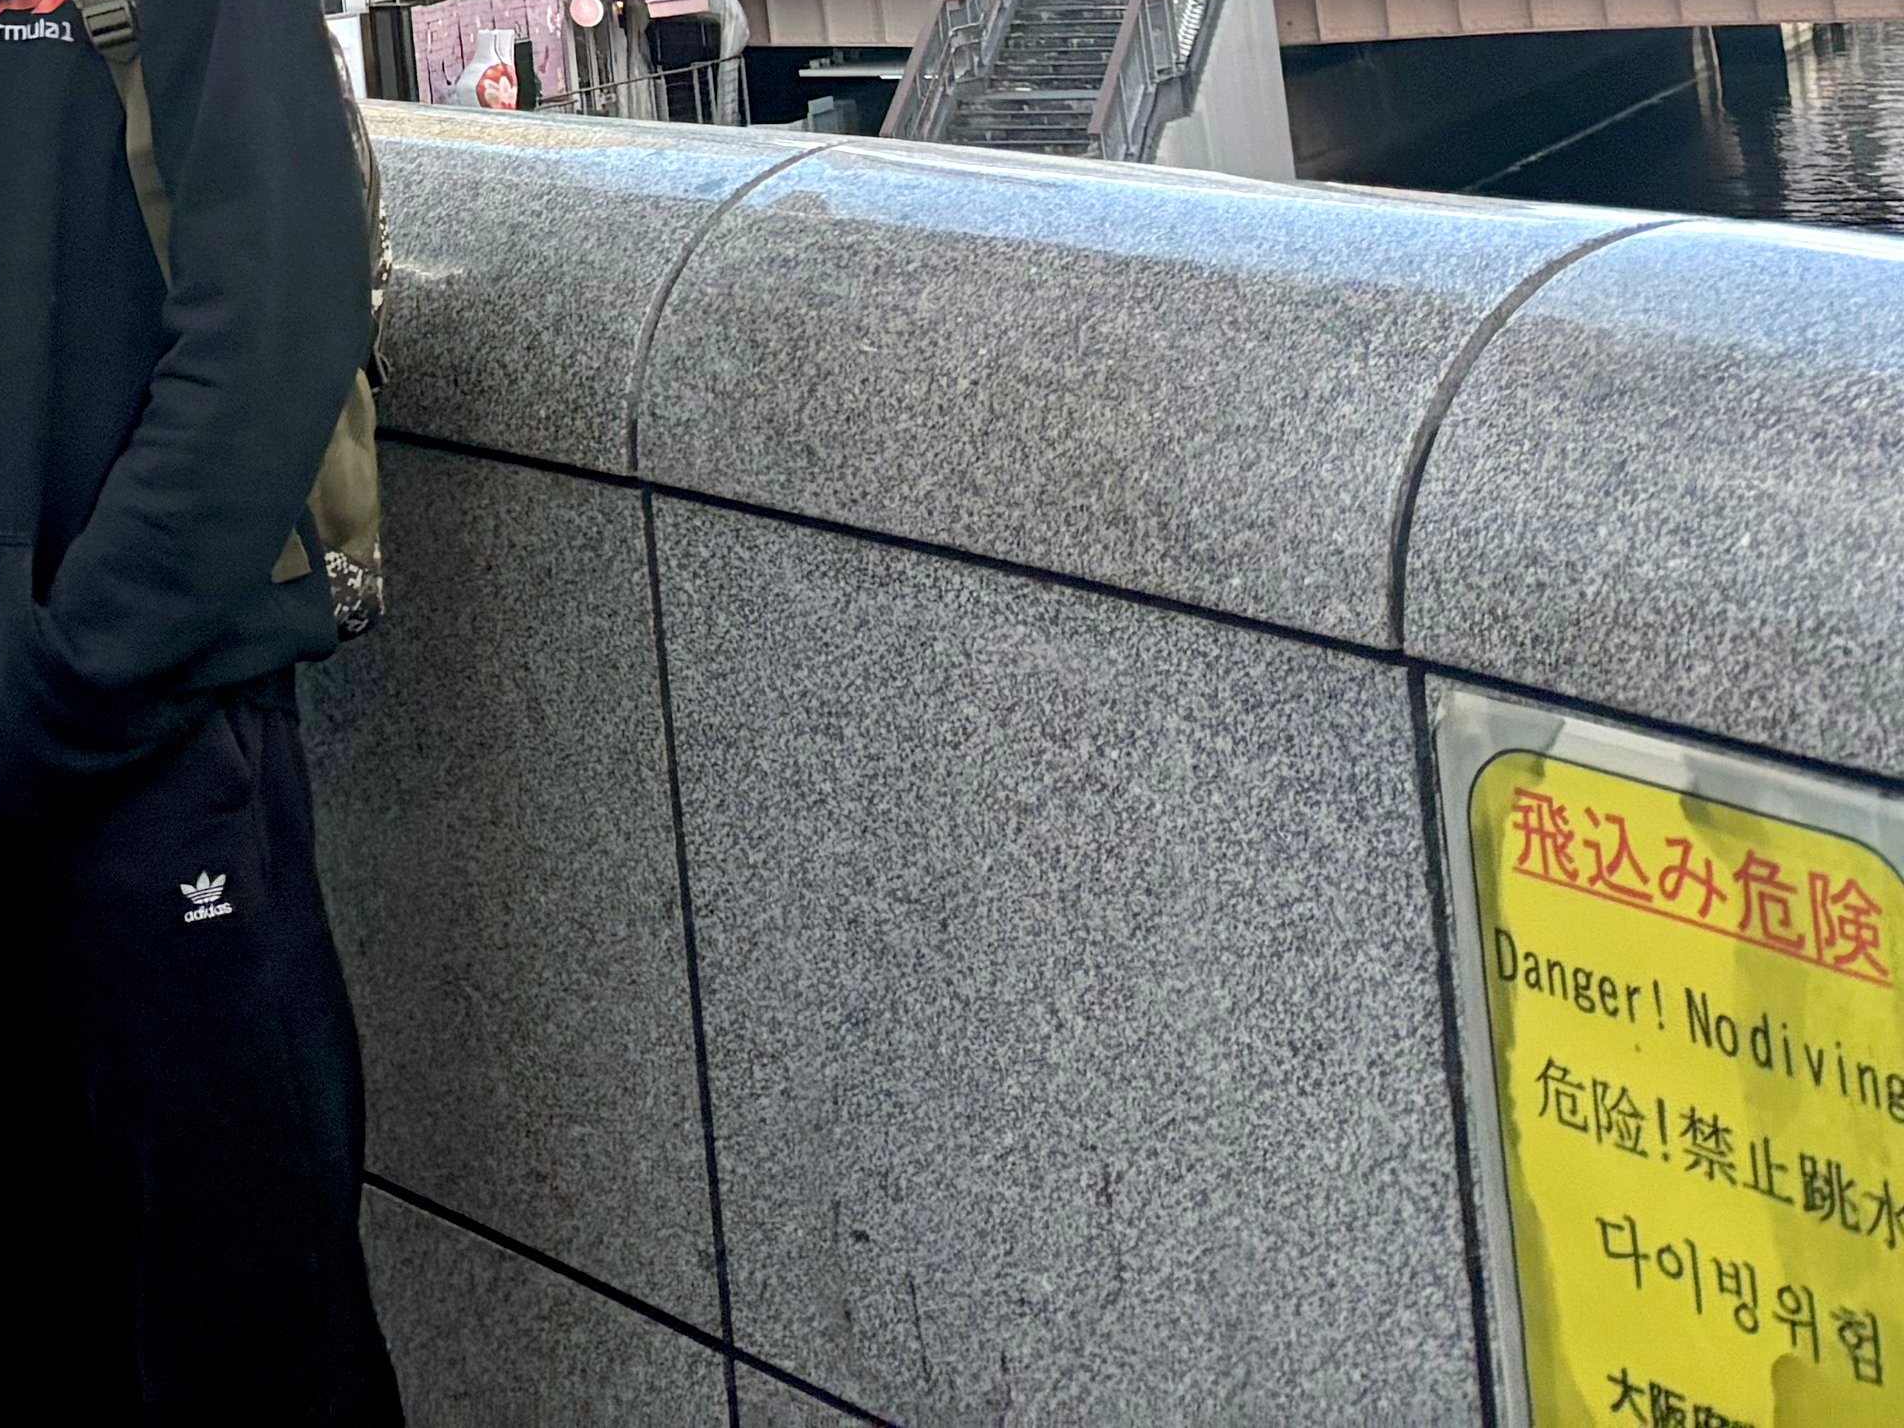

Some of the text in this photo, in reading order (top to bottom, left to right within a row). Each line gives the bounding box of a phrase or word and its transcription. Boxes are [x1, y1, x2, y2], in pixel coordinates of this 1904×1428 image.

[183, 901, 234, 924] adidas
[1511, 785, 1890, 981] 飛込み危険
[1494, 926, 1665, 1031] Danger!
[1596, 1212, 1885, 1389] 다이빙위험
